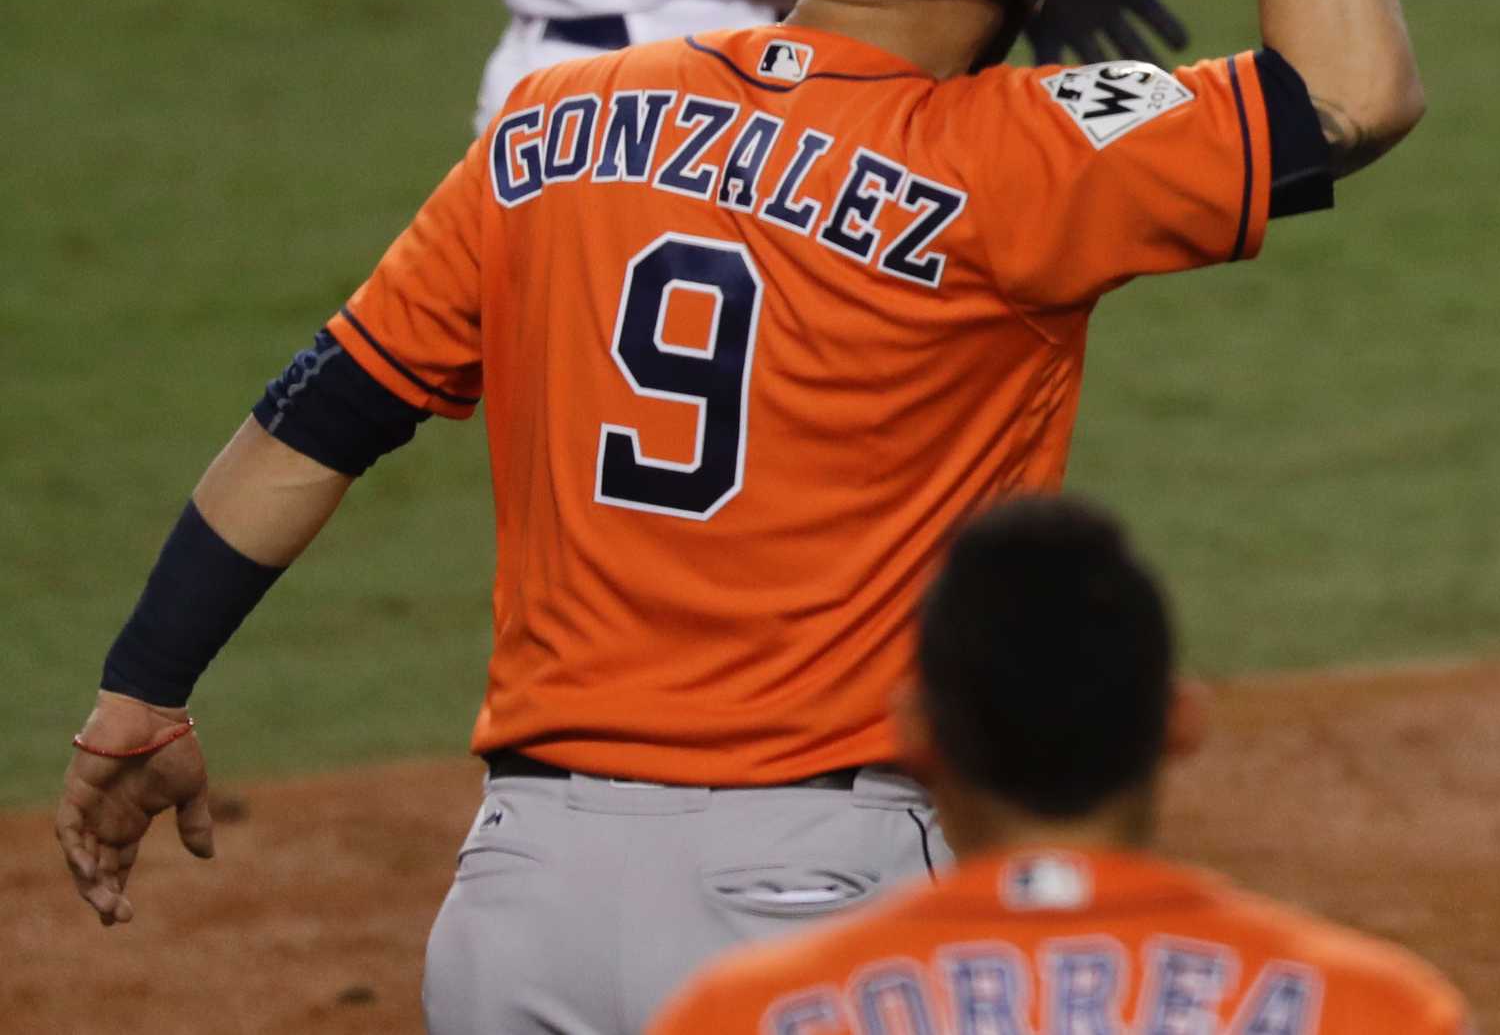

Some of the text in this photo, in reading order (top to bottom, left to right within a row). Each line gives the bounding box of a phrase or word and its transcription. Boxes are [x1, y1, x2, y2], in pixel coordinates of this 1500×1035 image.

[490, 89, 967, 289] GONZALEZ
[1082, 66, 1152, 120] WS
[593, 231, 764, 521] 9
